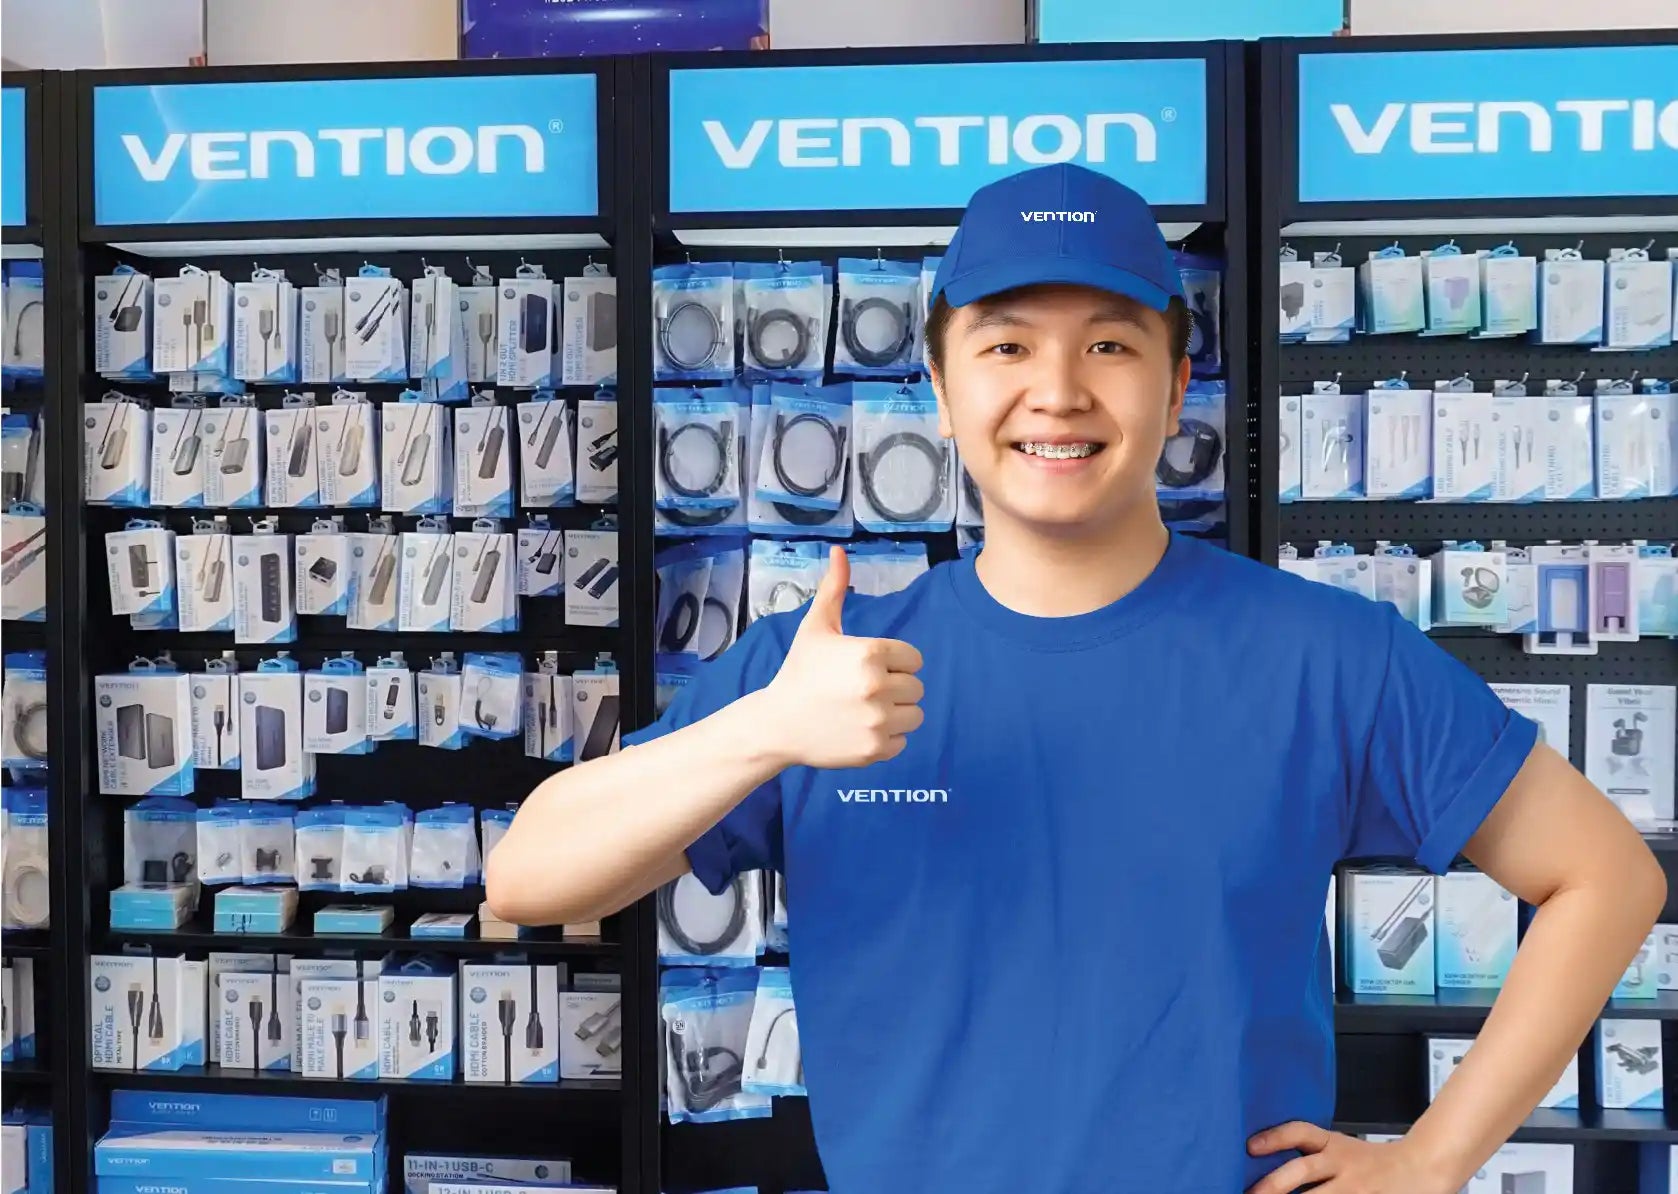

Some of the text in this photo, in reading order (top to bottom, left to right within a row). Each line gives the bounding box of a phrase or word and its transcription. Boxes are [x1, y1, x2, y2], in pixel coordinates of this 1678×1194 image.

[121, 124, 544, 181] VENTION
[701, 112, 1157, 169] VENTION
[1020, 211, 1095, 223] VENTION
[836, 789, 948, 803] VENTION
[94, 1021, 103, 1063] OPTICAL
[105, 1004, 114, 1063] HDMI CABLE
[225, 1009, 234, 1063] HDMI CABLE
[383, 1017, 391, 1074] HDMI CABLE
[470, 1013, 480, 1077] HDMI CABLE
[149, 1101, 200, 1111] VENTION
[408, 1159, 494, 1173] 11-IN-1 USB-C
[408, 1171, 465, 1180] DOCKING STATION
